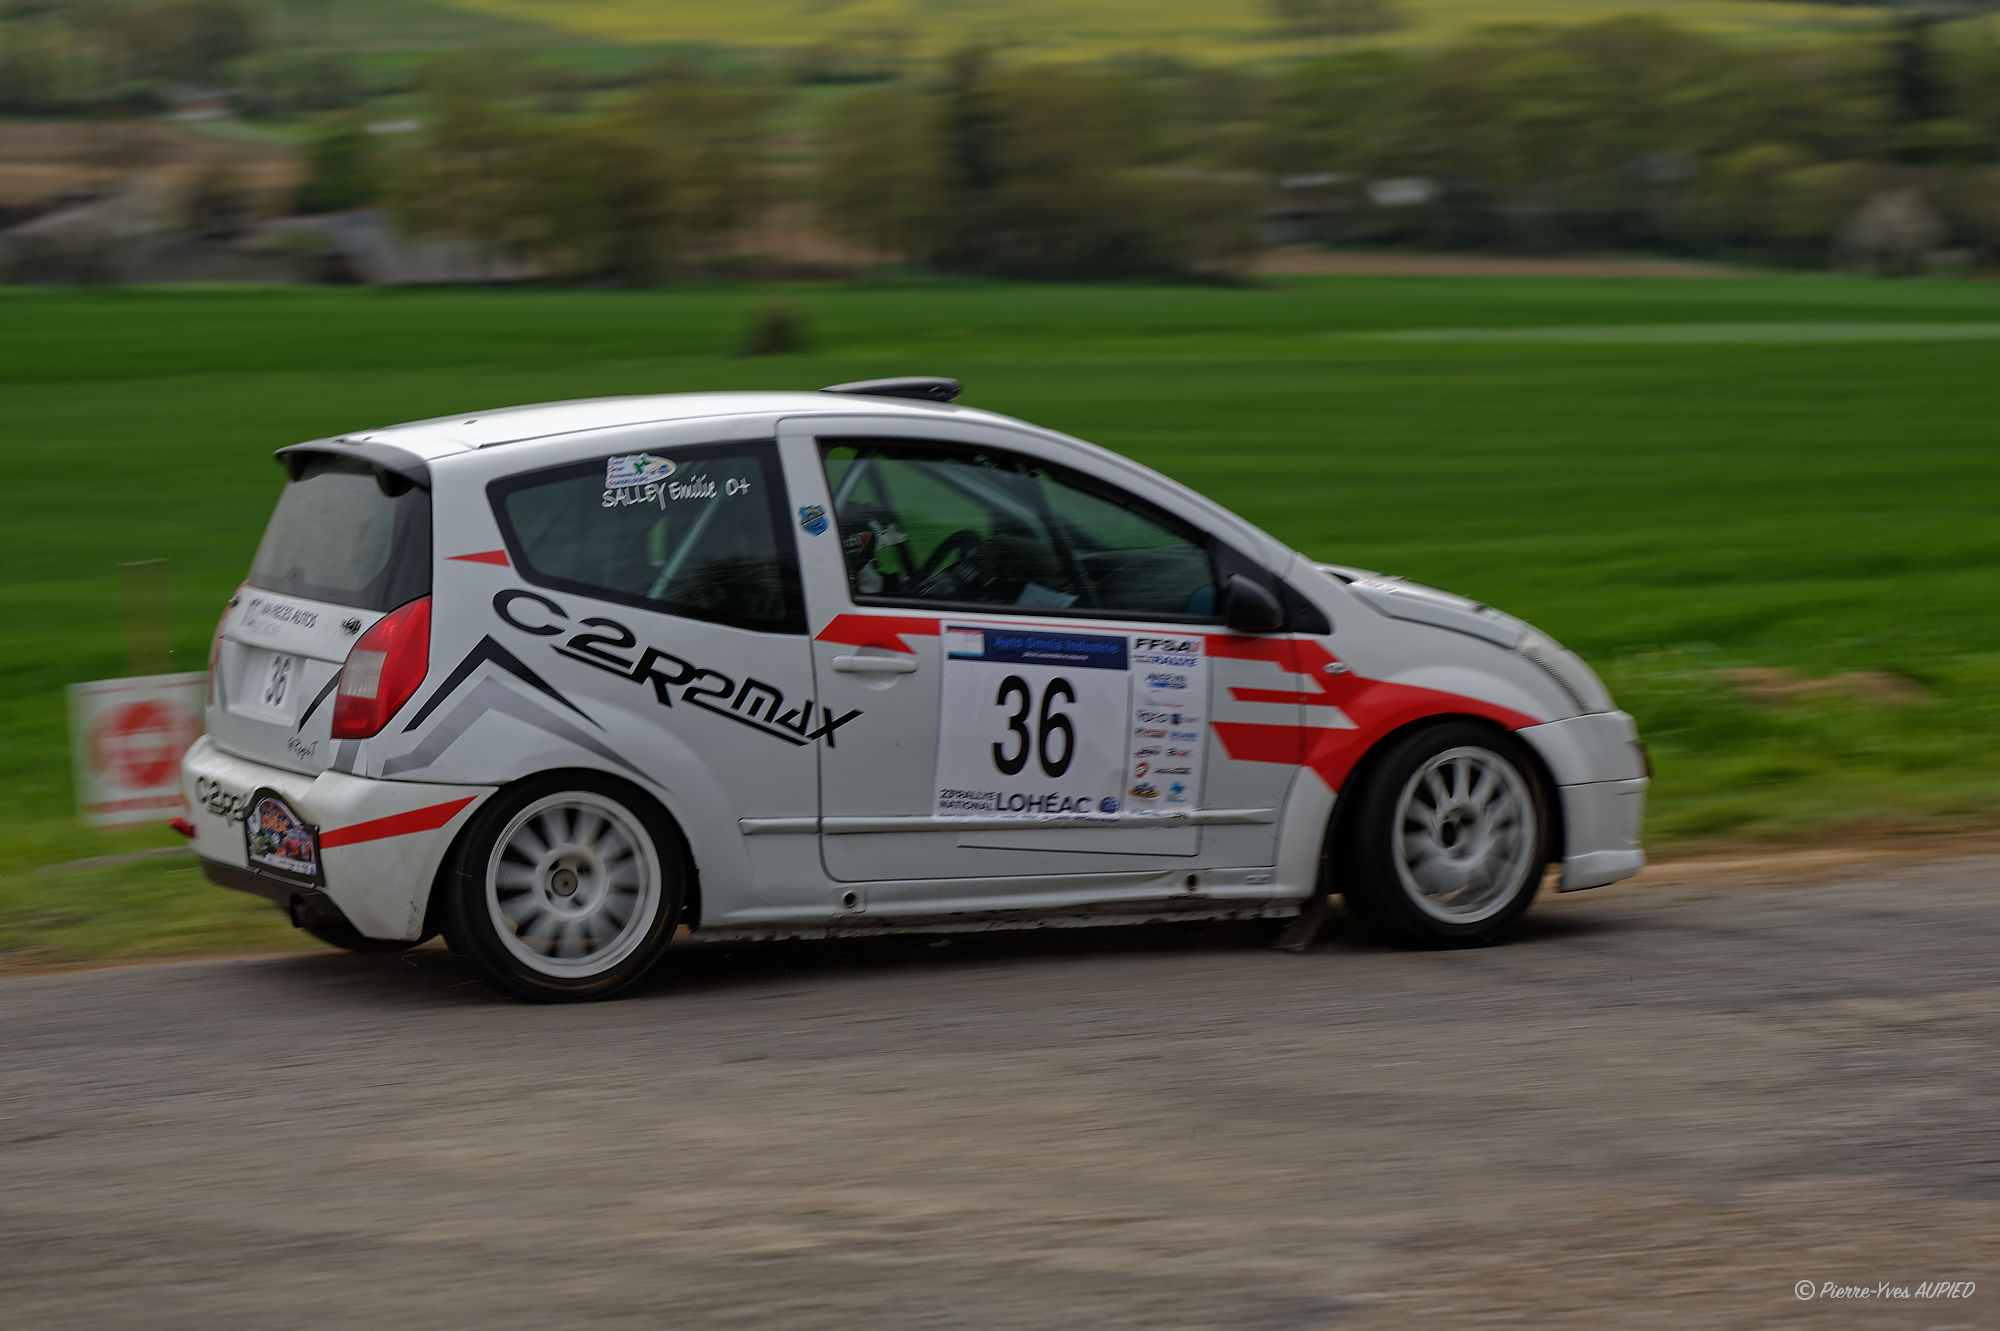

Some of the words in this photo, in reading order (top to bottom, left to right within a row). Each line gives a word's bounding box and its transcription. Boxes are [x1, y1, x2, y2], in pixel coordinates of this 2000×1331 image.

[602, 482, 666, 511] SALLEY
[1134, 638, 1191, 652] FFSA
[264, 655, 291, 706] 36
[991, 674, 1077, 778] 36
[938, 800, 996, 812] NATIONAL
[996, 791, 1092, 814] LOHÉAC
